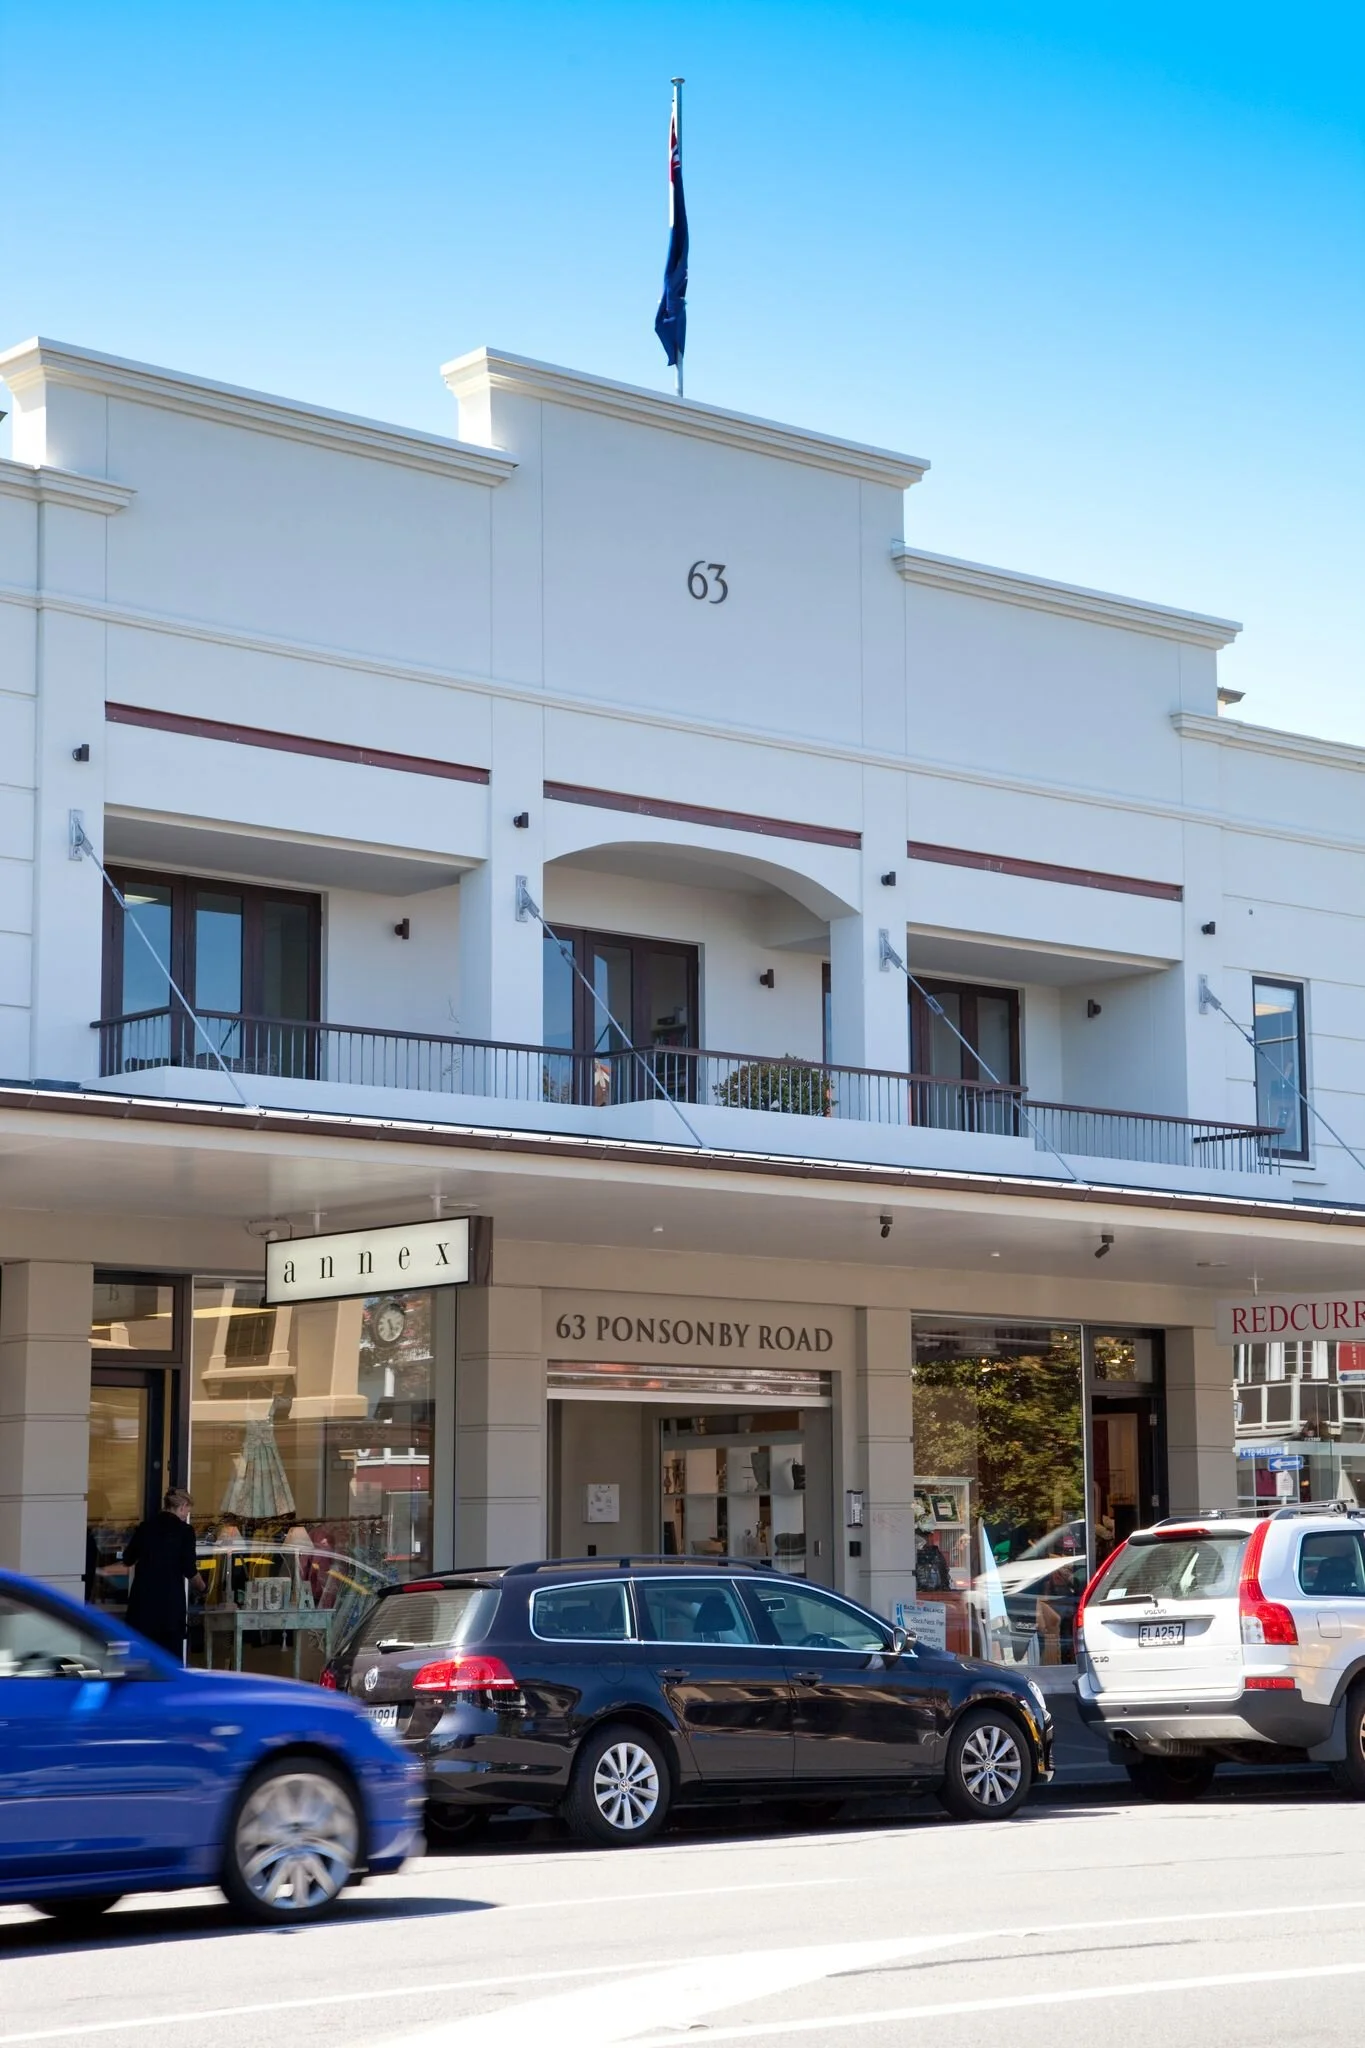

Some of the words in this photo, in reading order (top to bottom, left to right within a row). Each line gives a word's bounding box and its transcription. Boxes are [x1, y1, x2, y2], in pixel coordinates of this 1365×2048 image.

[687, 560, 728, 604] 63
[283, 1242, 451, 1284] annex
[556, 1313, 586, 1340] 63
[596, 1315, 750, 1348] PONSONBY
[758, 1325, 834, 1352] ROAD
[1141, 1625, 1182, 1641] ELA257
